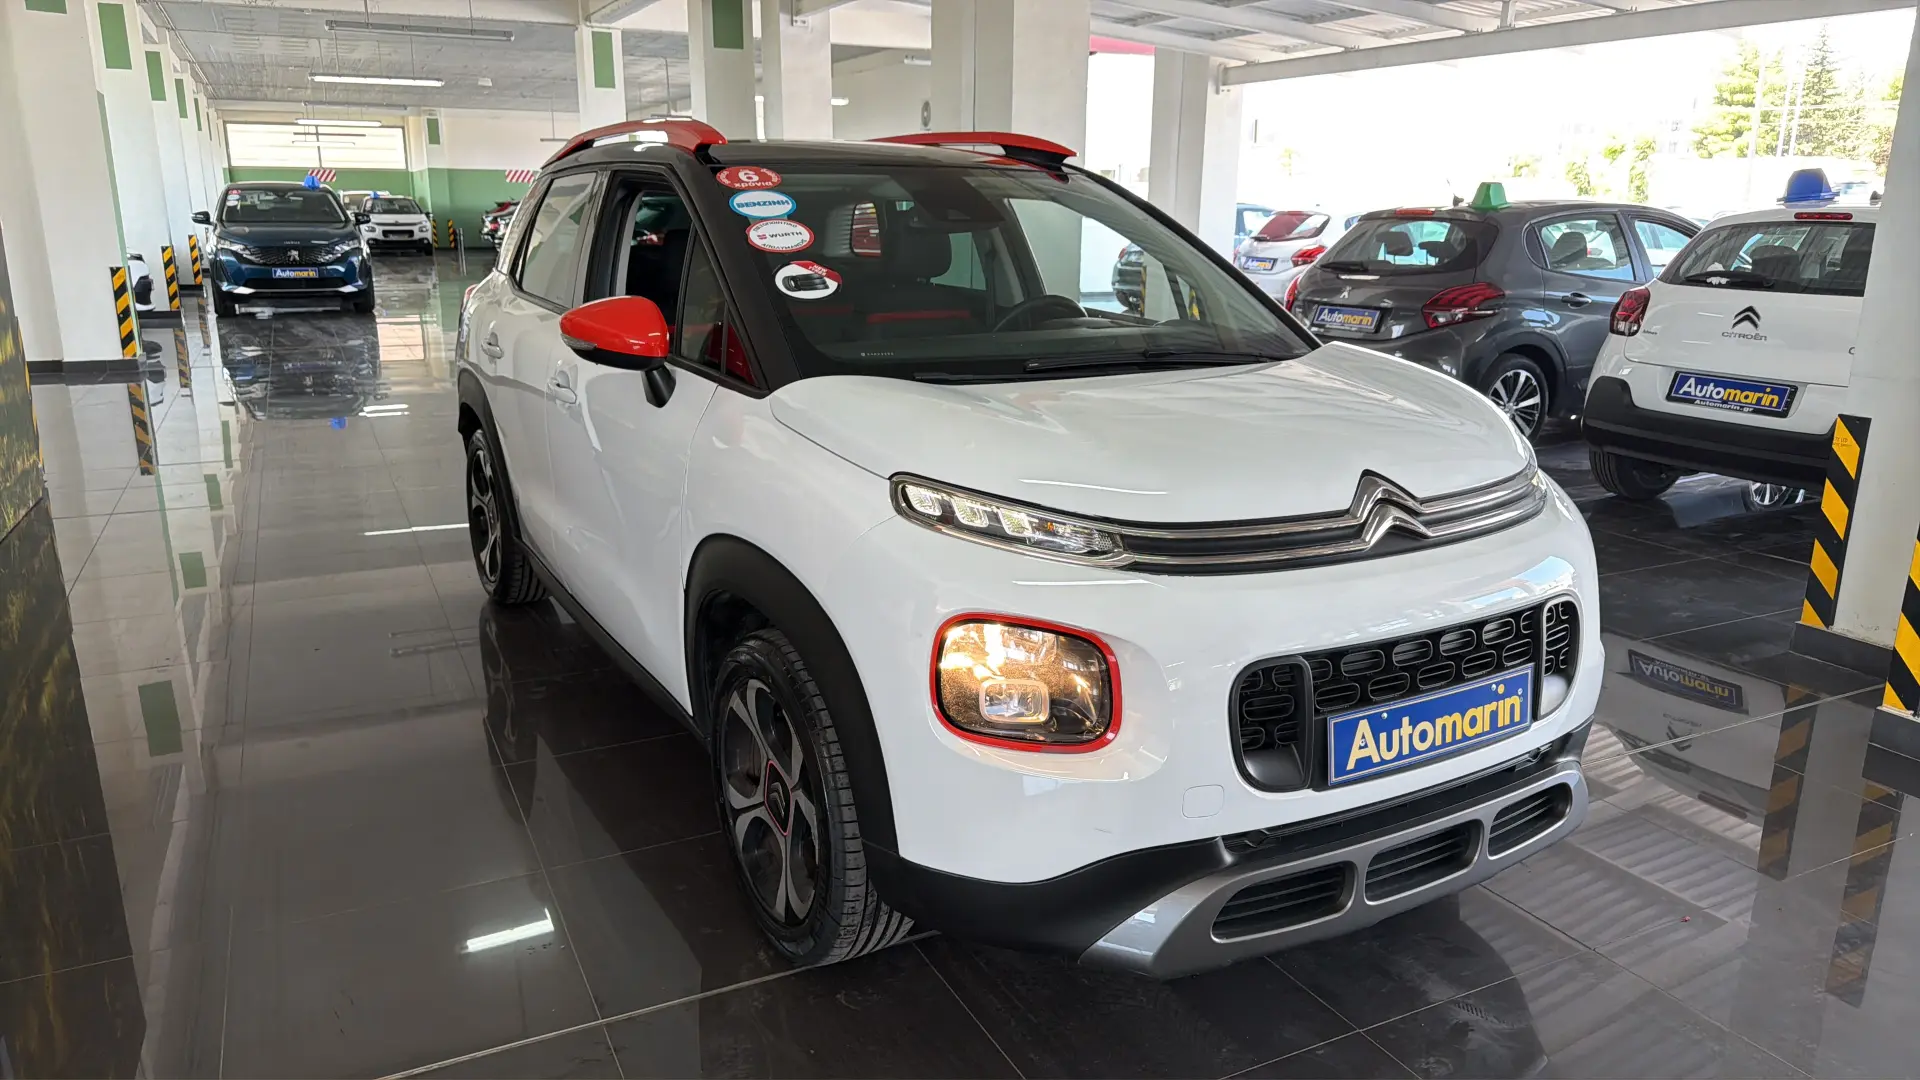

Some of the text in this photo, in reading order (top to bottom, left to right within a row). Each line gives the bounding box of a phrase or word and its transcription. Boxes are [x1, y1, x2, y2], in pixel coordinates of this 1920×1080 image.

[738, 170, 759, 182] 6
[276, 268, 316, 277] Automarin
[1318, 308, 1373, 326] Automarin
[1679, 377, 1779, 408] Automarin
[1694, 400, 1754, 412] Automarin.gr
[1345, 683, 1520, 771] Automarin
